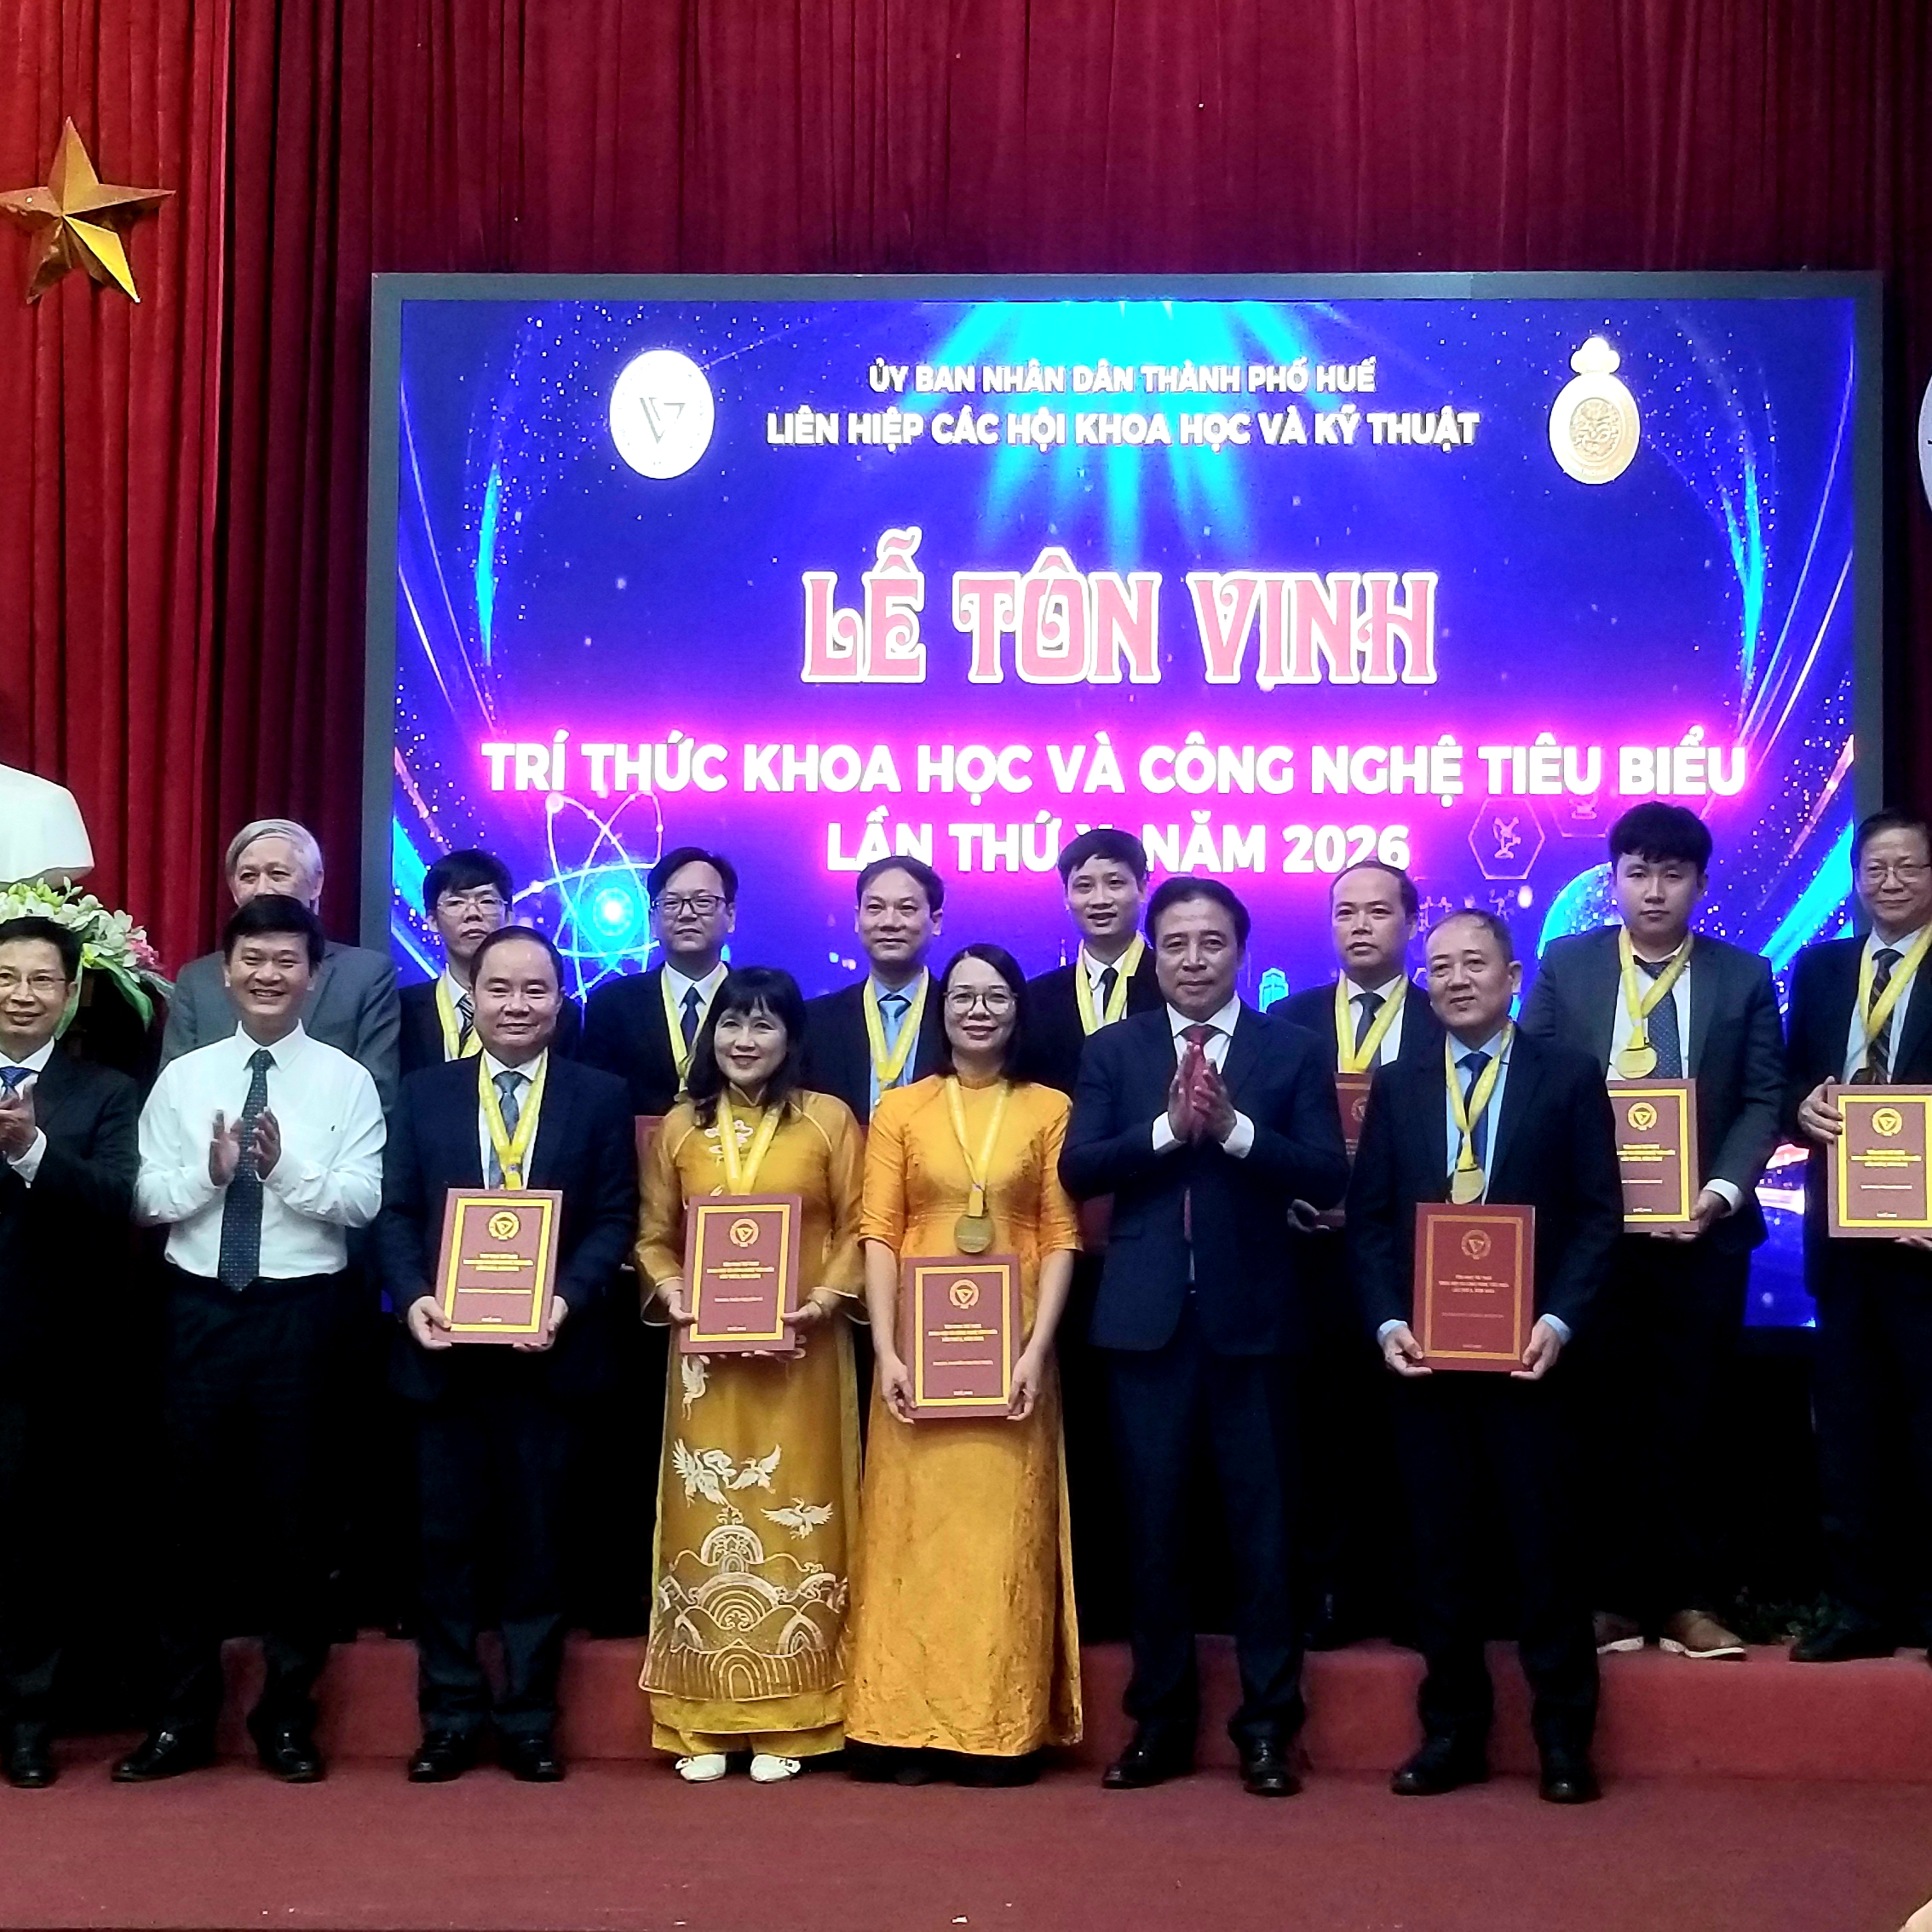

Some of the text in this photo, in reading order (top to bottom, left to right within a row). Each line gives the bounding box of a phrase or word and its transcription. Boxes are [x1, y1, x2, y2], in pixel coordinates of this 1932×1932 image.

[869, 356, 1377, 393] ỦY BAN NHÂN DÂN THÀNH PHỐ HUẾ
[767, 404, 1481, 452] LIÊN HIỆP CÁC HỘI KHOA HỌC VÀ KỸ THUẬT
[801, 526, 1438, 685] LỄ TÔN VINH
[481, 725, 1746, 808] TRÍ THỨC KHOA HỌC VÀ CÔNG NGHỆ TIÊU BIỂU
[827, 805, 1411, 874] LẦN THỨ NĂM 2026
